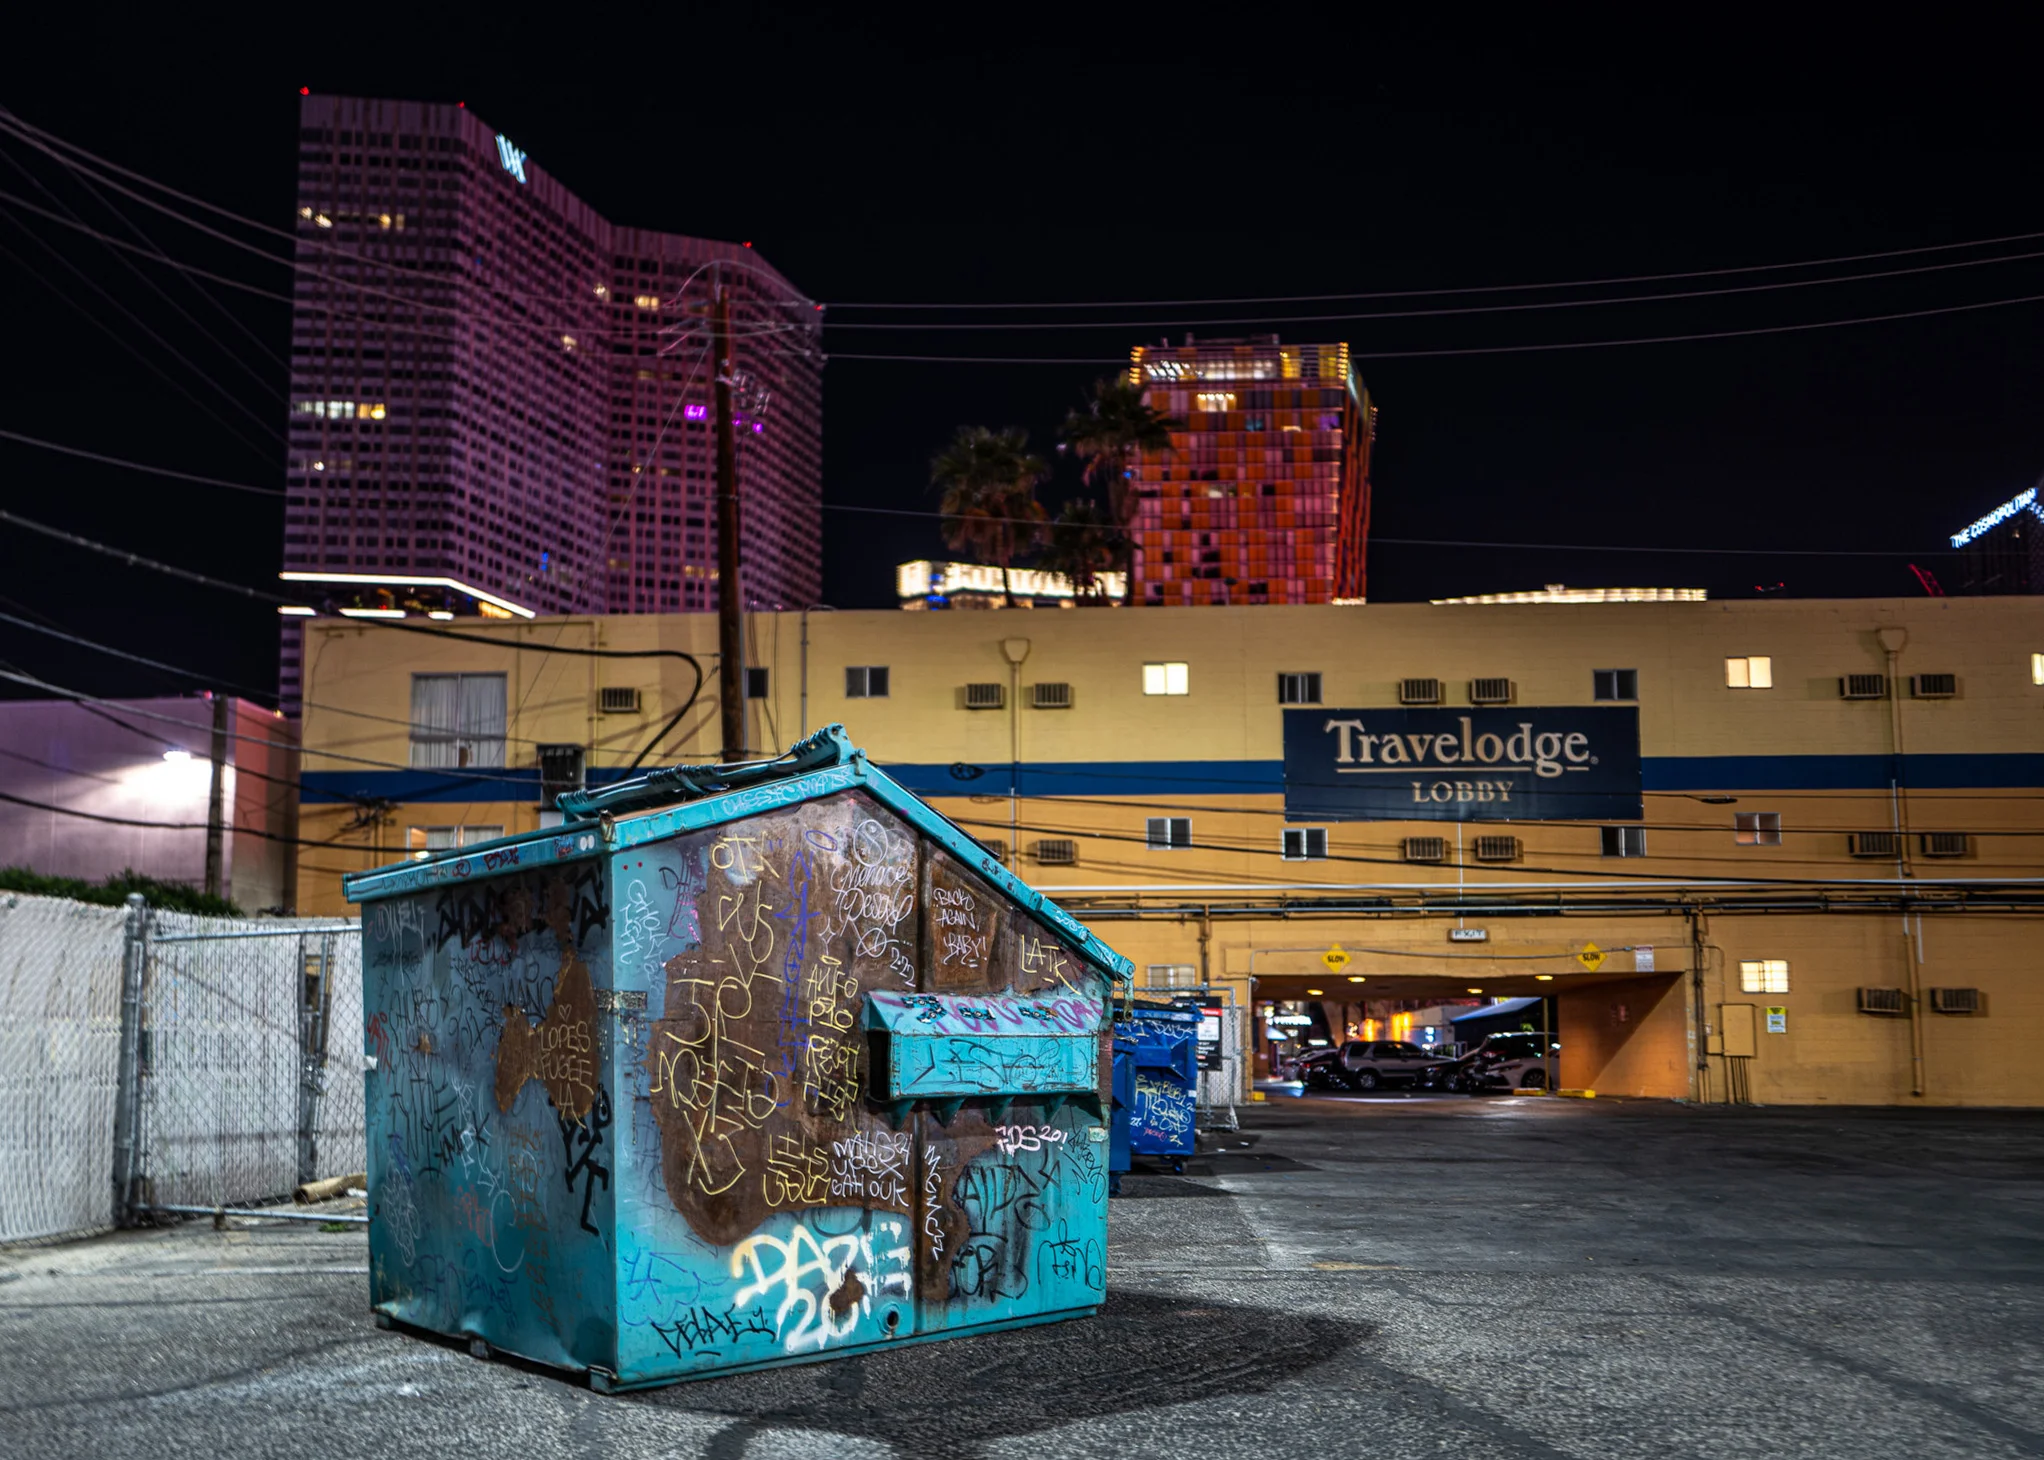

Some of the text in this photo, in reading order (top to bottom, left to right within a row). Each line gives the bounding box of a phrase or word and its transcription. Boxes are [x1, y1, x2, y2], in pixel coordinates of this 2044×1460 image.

[1324, 716, 1590, 777] Travelodge
[1411, 780, 1514, 803] LOBBY
[1327, 955, 1345, 963] SLOW
[1582, 952, 1601, 961] SLOW
[540, 1020, 591, 1053] LOPES
